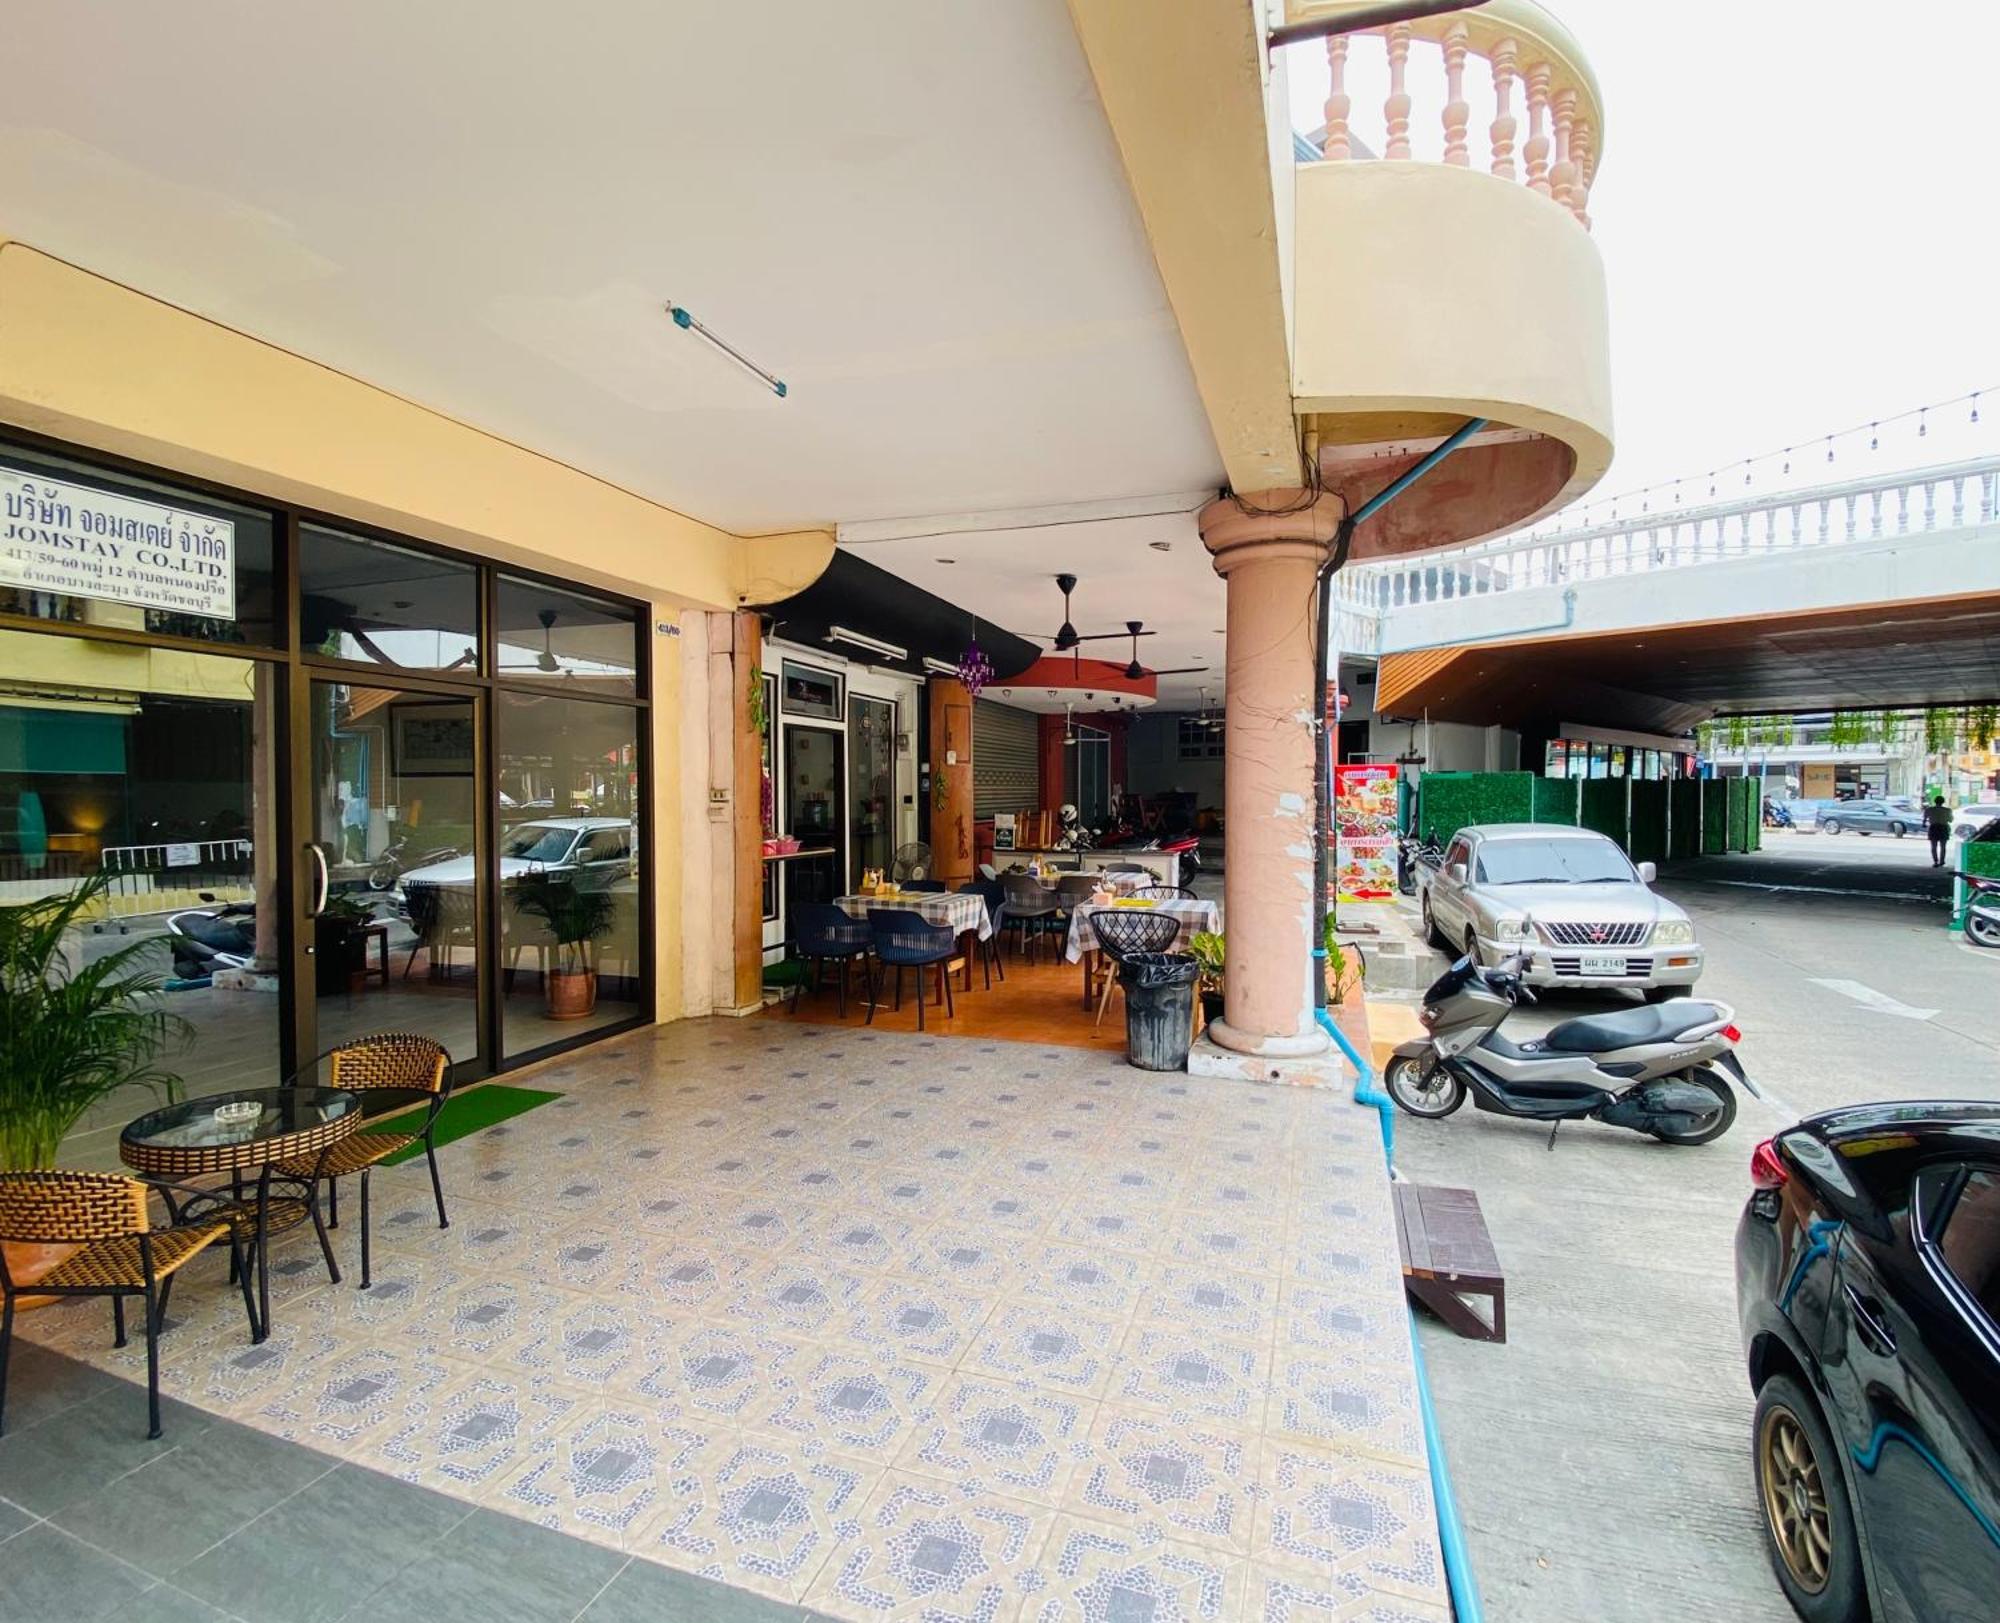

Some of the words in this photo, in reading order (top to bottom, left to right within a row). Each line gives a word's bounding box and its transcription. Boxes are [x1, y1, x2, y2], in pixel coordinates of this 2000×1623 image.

[5, 483, 72, 529] บริษัท
[79, 511, 173, 549] จอมสเตย์
[180, 521, 227, 561] จำกัด
[4, 524, 124, 559] JOMSTAY
[137, 550, 228, 579] CO.,LTD.
[108, 565, 123, 577] 12
[1602, 959, 1625, 968] 2149
